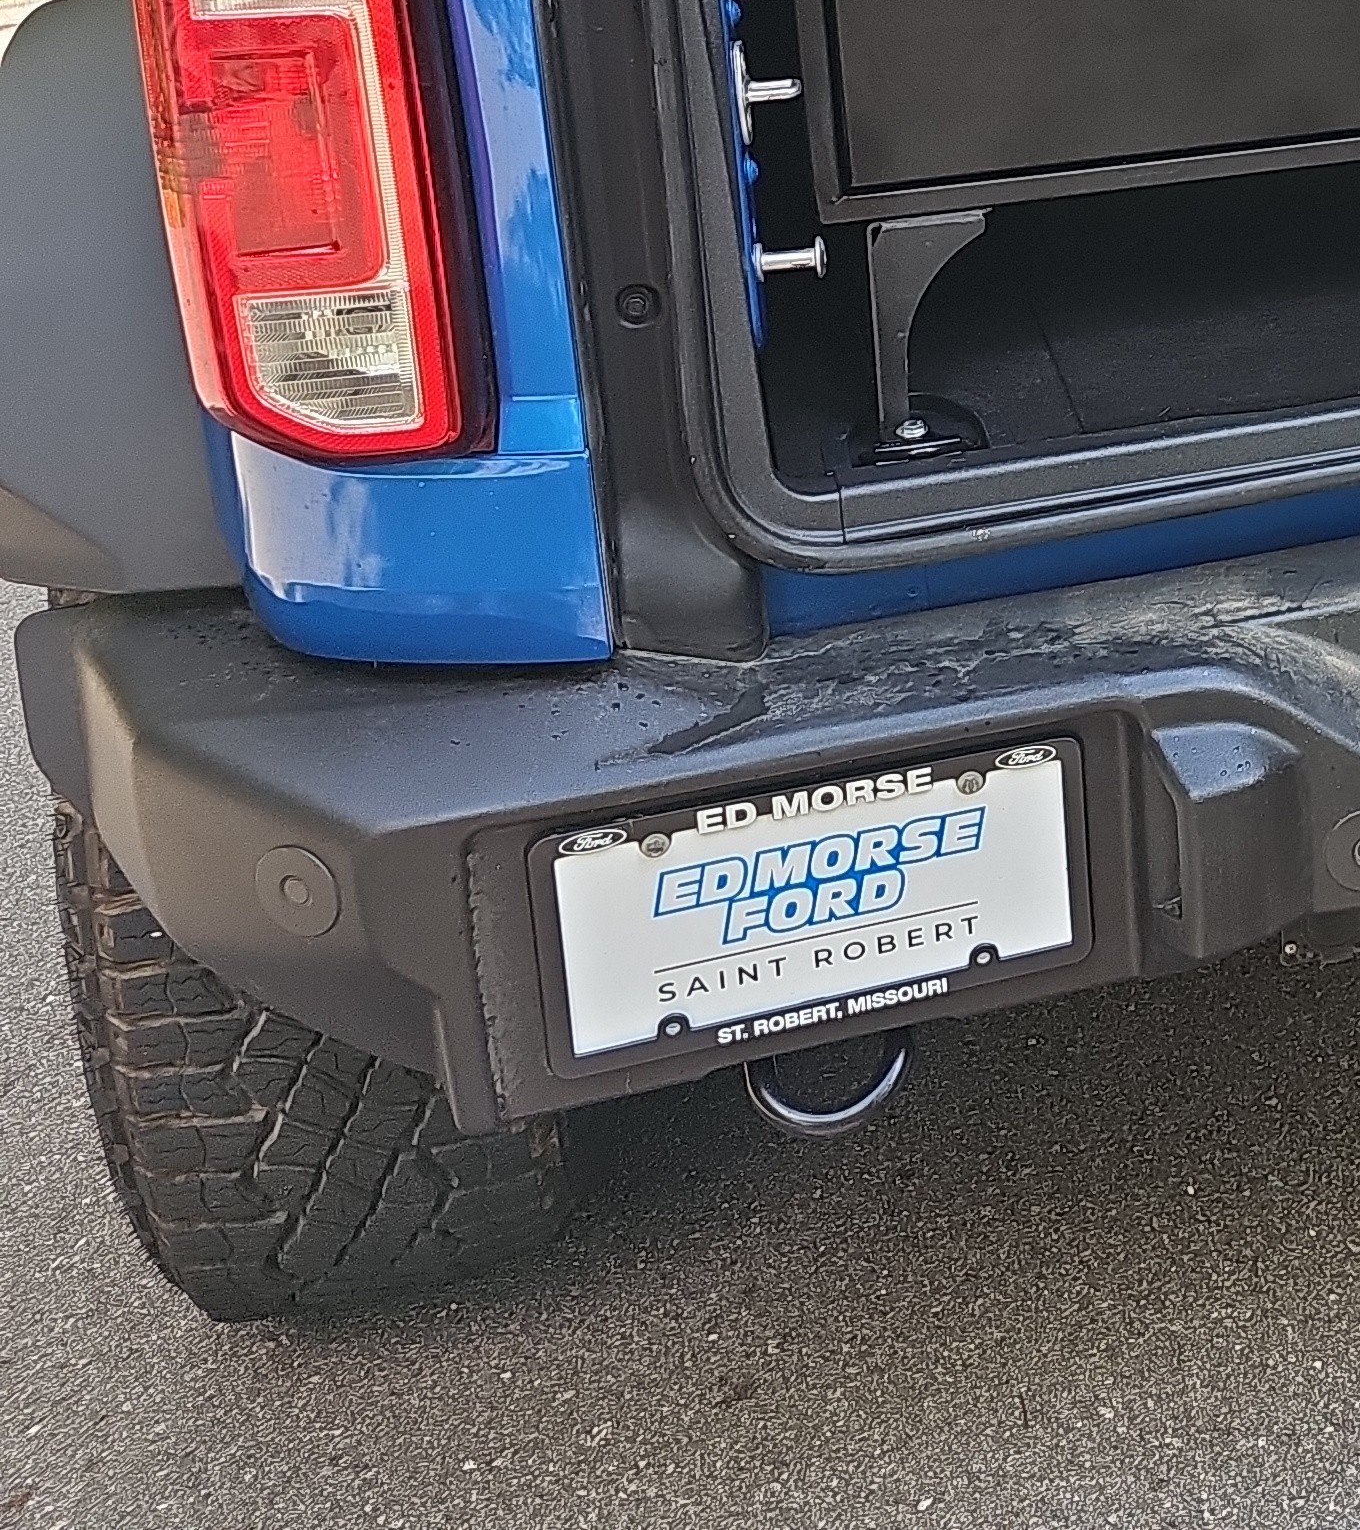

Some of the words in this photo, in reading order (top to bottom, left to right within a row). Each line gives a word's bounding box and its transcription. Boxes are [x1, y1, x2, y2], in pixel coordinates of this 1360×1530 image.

[695, 800, 757, 836] ED
[771, 766, 934, 820] MORSE
[721, 869, 906, 945] FORD
[657, 955, 789, 1004] SAINT
[813, 914, 979, 970] ROBERT
[716, 1024, 749, 1045] ST.
[753, 1000, 844, 1038] ROBERT,
[846, 977, 949, 1017] MISSOURI
